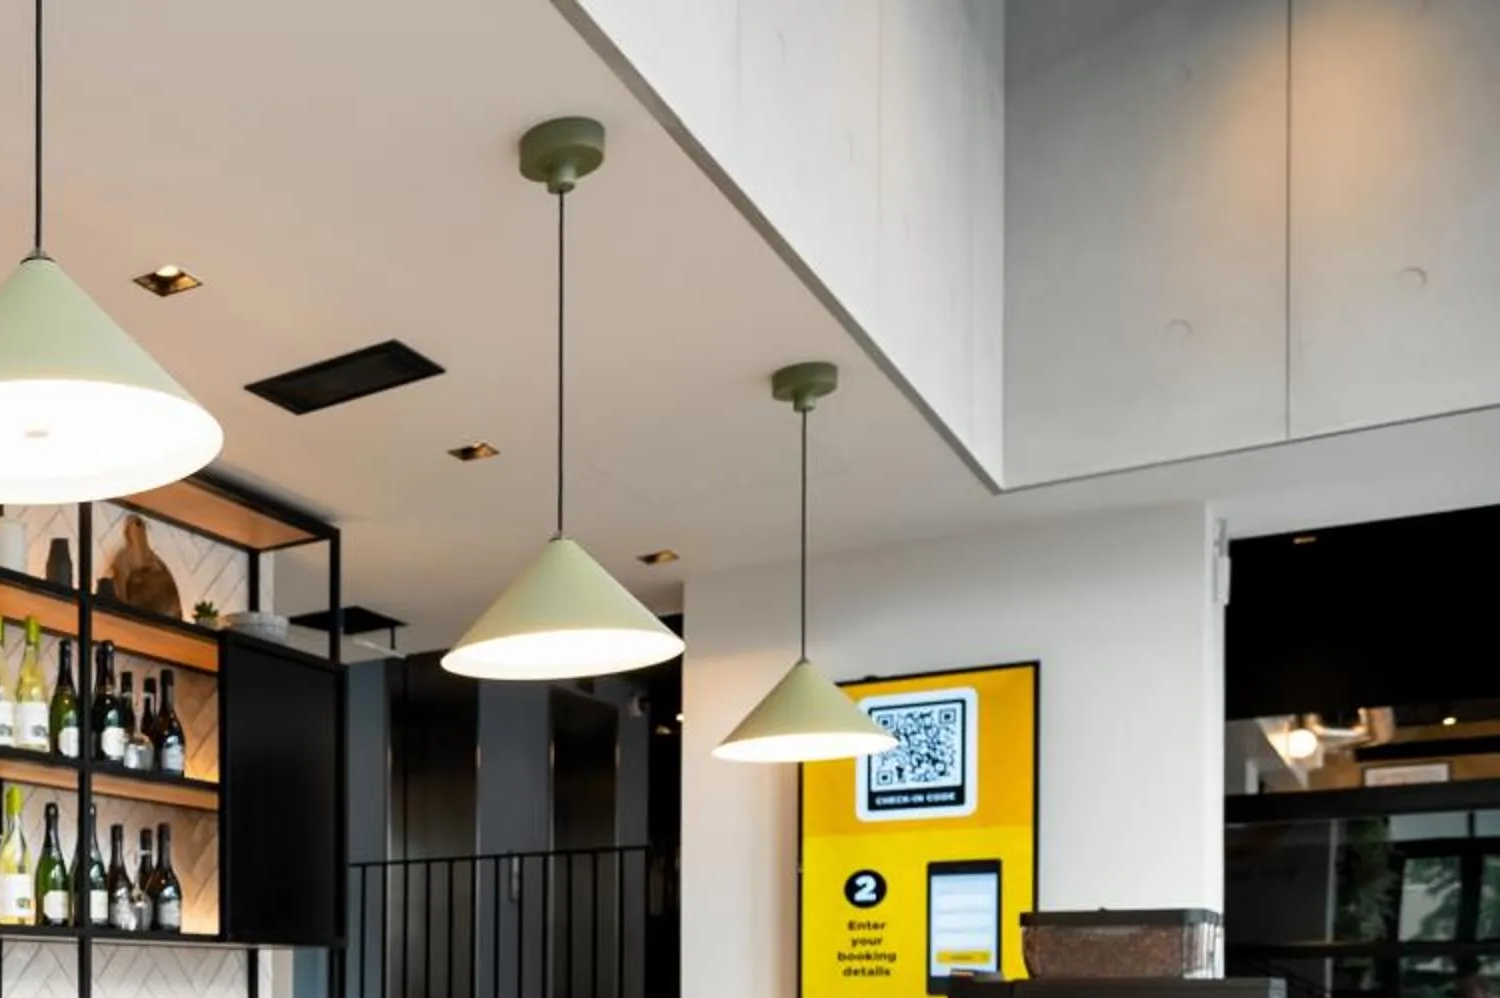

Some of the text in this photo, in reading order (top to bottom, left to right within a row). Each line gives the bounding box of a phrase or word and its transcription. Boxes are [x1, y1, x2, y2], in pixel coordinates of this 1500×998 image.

[925, 791, 956, 804] CODE
[853, 874, 877, 902] 2
[847, 920, 886, 931] Enter
[851, 937, 883, 948] your
[837, 951, 897, 963] booking
[843, 966, 891, 977] details
